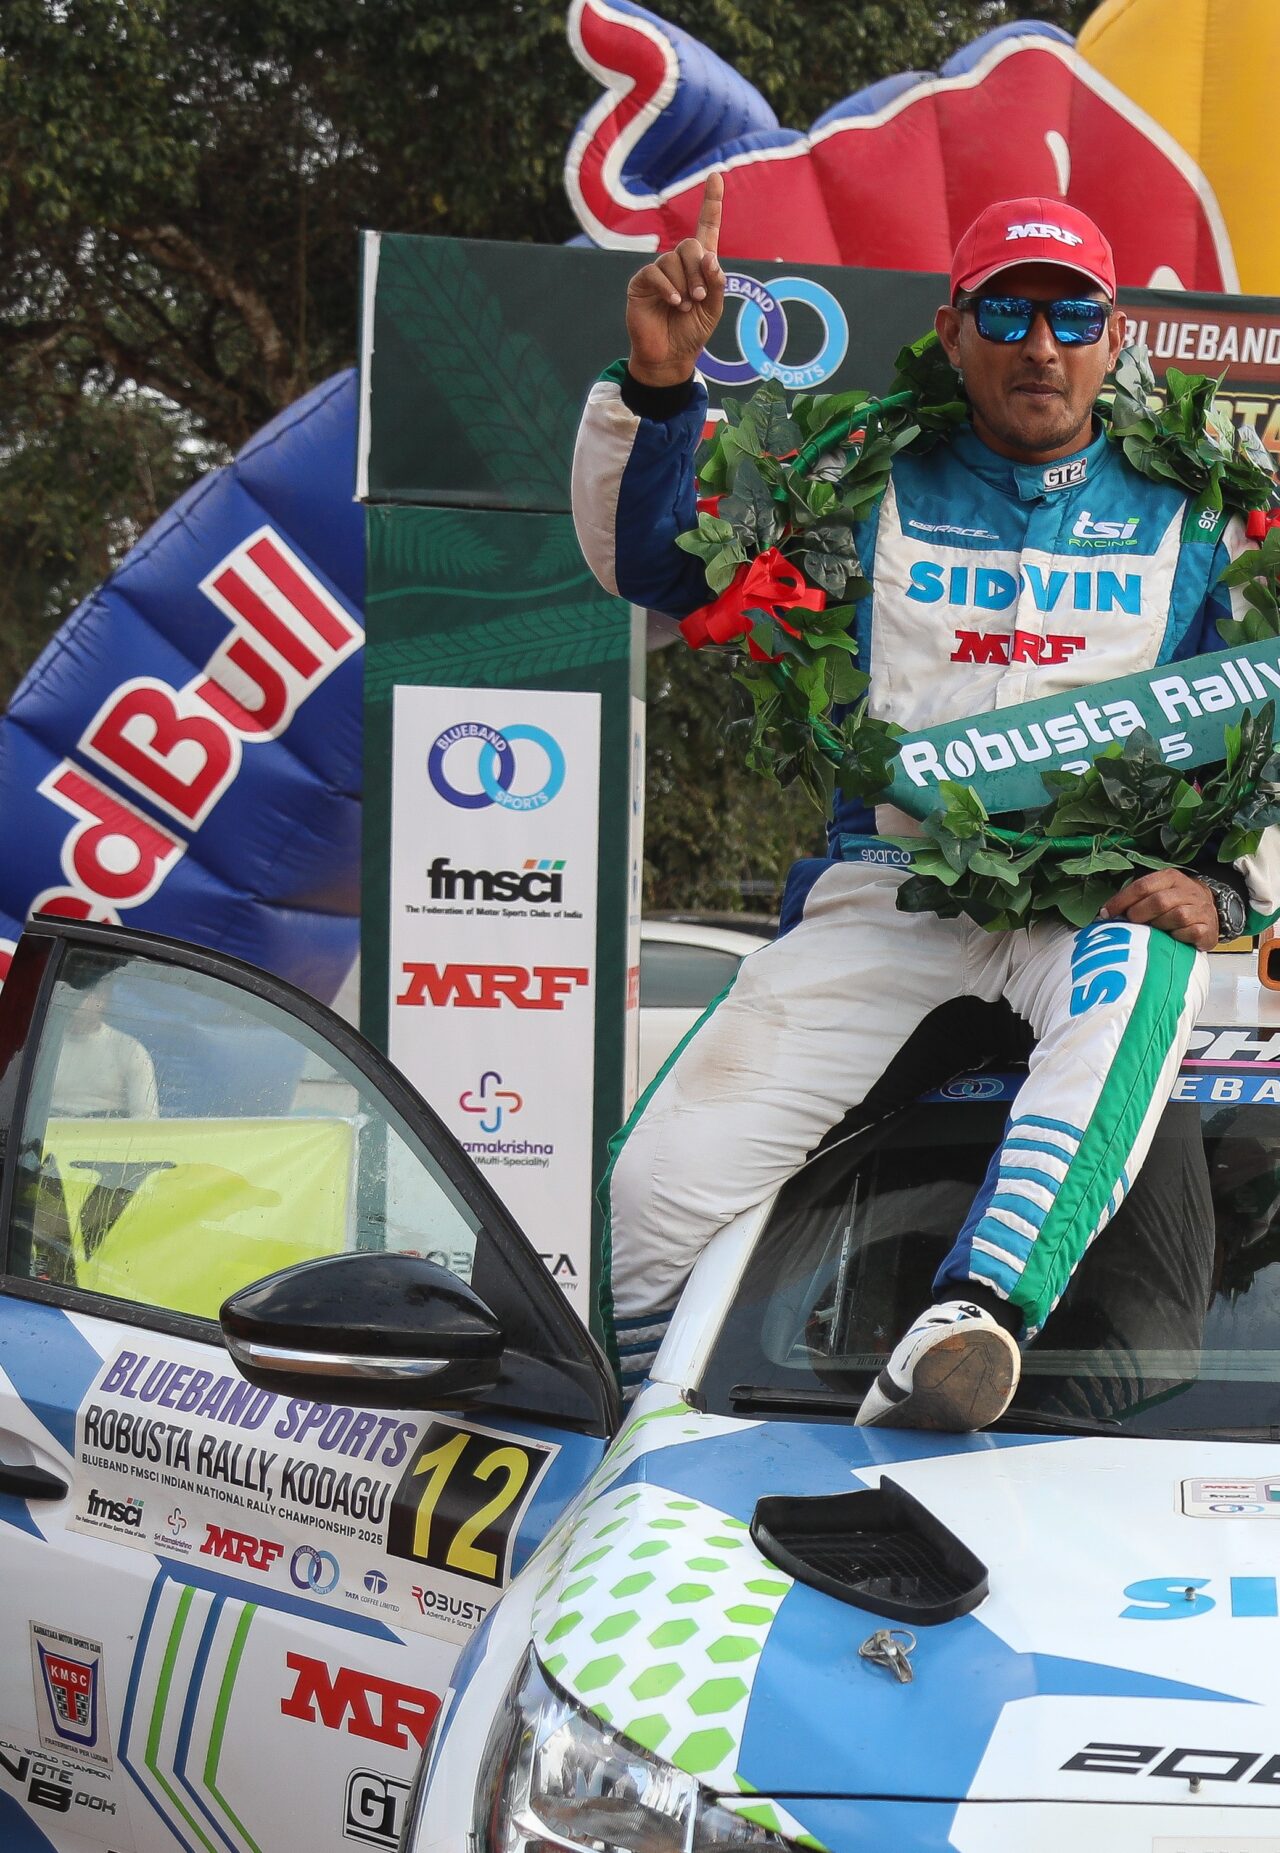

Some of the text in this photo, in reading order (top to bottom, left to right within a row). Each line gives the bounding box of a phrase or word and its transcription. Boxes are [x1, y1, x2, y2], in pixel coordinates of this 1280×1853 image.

[1005, 222, 1084, 247] MRF
[760, 361, 826, 385] SPORTS
[1069, 538, 1138, 547] RACING
[1073, 512, 1140, 539] tsi
[905, 561, 1141, 615] SIDVIN
[950, 630, 1085, 665] MRF
[84, 530, 359, 825] Bull
[437, 724, 507, 752] BLUEBAND
[901, 698, 1146, 787] Robusta
[495, 790, 549, 811] SPORTS
[861, 848, 911, 866] sparco
[427, 857, 562, 903] fmsci
[405, 905, 419, 914] The
[422, 906, 464, 915] Federation
[476, 908, 500, 916] Motor
[502, 908, 527, 918] Sports
[563, 911, 583, 919] India
[396, 962, 590, 1010] MRF
[1069, 921, 1133, 1018] SID
[458, 1140, 554, 1155] amakrishna
[474, 1156, 550, 1168] (Multi-Speciality)
[100, 1350, 418, 1468] BLUEBAND SPORTS
[84, 1404, 392, 1525] ROBUSTA RALLY, KODAGU
[82, 1453, 383, 1545] BLUEBAND FMSCI INDIAN NATIONAL RALLY CHAMPIONSHIP 2025
[87, 1488, 144, 1528] fmsci
[410, 1432, 530, 1580] 12
[200, 1522, 285, 1572] MRF
[345, 1591, 400, 1612] TATA COFFEE LIMITED
[411, 1585, 487, 1622] ROBUST
[51, 1664, 87, 1687] KMSC
[280, 1650, 443, 1751] MR
[24, 1748, 111, 1781] WORLD CHAMPION
[27, 1777, 116, 1816] BOOK
[348, 1775, 411, 1832] GT
